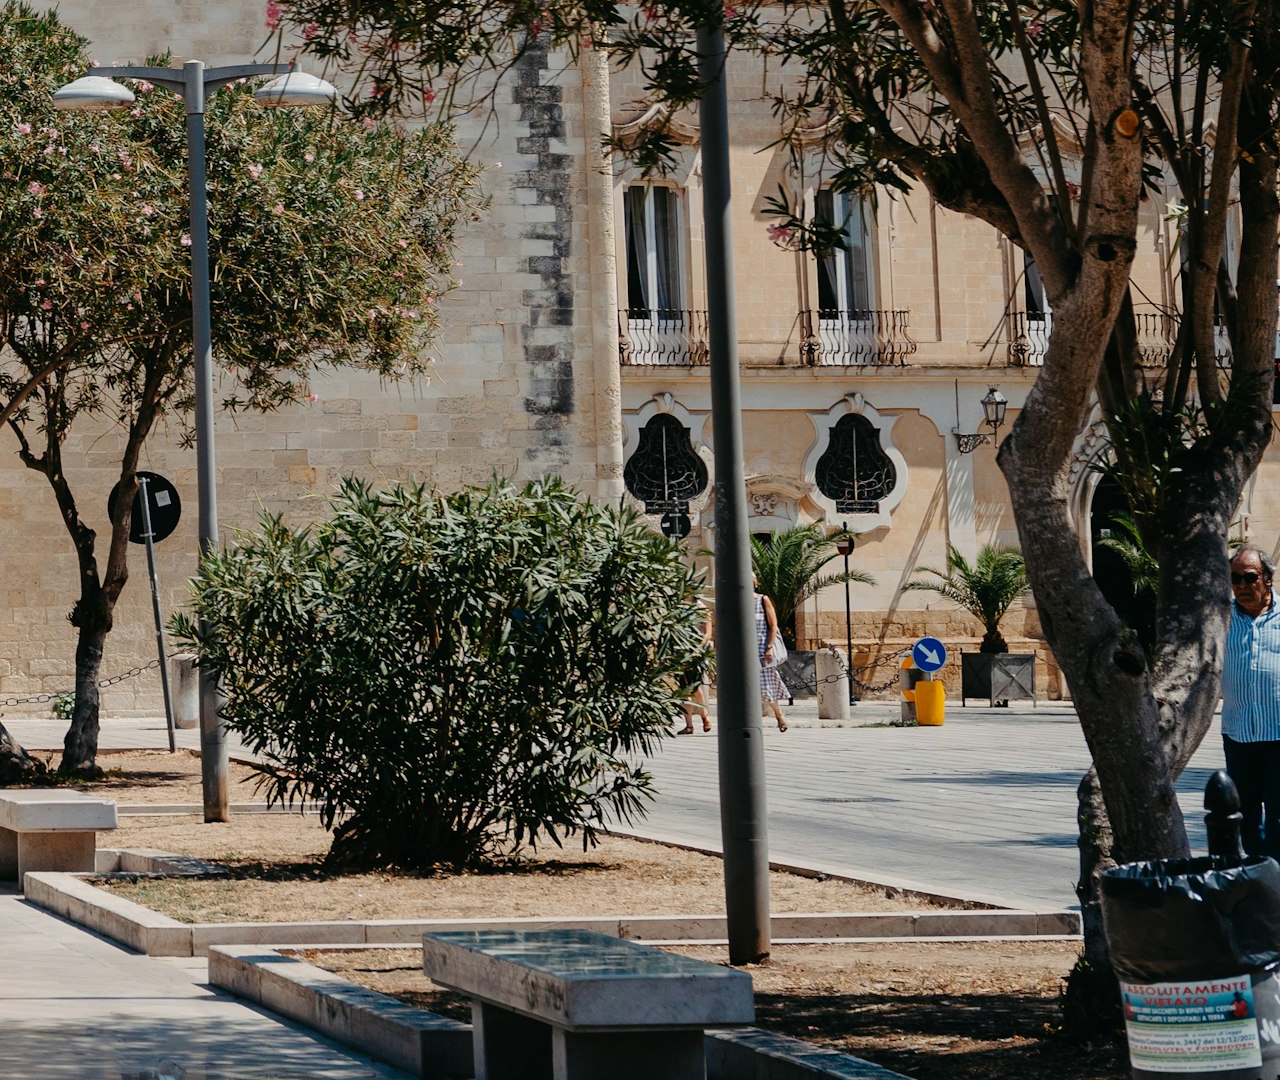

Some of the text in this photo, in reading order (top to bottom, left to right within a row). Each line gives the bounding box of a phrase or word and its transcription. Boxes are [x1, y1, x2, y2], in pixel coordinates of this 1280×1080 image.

[1128, 981, 1247, 996] ASSOLUTAMENTE
[1144, 997, 1207, 1007] VIETATO
[1216, 1034, 1256, 1044] 12/12/2022
[1195, 1042, 1254, 1052] FORBIDDEN
